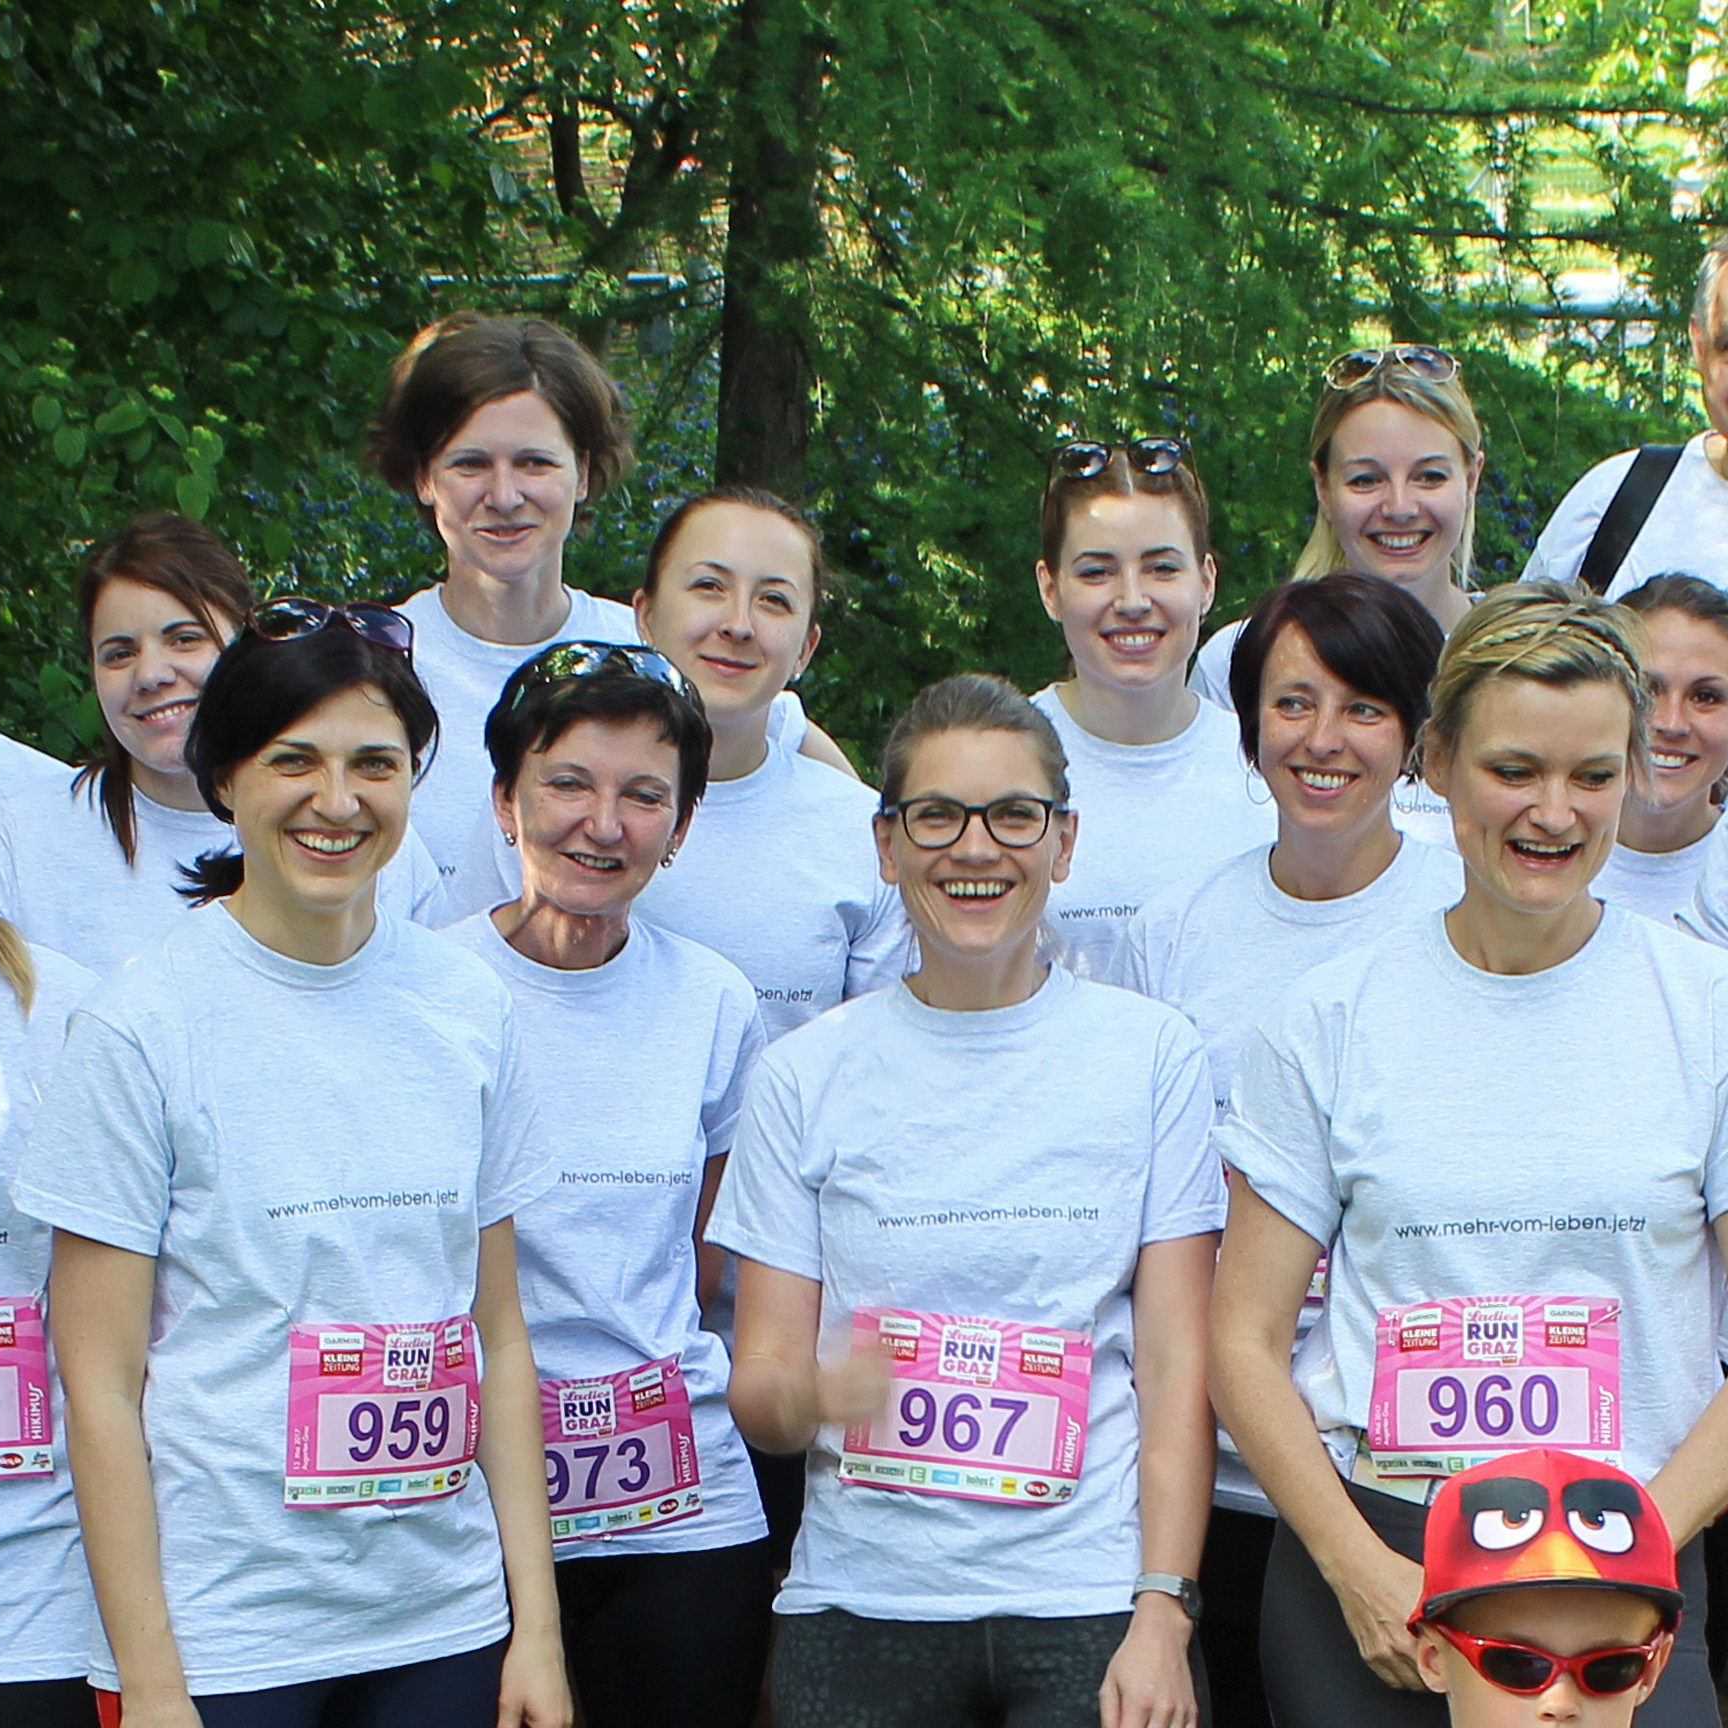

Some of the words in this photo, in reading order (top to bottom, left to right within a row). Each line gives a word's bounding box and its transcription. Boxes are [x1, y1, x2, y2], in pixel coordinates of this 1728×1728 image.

[1059, 904, 1138, 920] www.mehr
[876, 1205, 1099, 1228] www.mehr-vom-leben.jetzt
[1394, 1215, 1646, 1239] www.mehr-vom-leben.jetzt
[1406, 1313, 1438, 1323] GARMIN
[1468, 1311, 1519, 1323] Ladies
[1549, 1310, 1585, 1318] GARMIN
[947, 1329, 998, 1344] Ladies
[1402, 1327, 1438, 1339] KLEINE
[1467, 1323, 1518, 1340] RUN
[1548, 1325, 1585, 1336] KLEINE
[325, 1337, 361, 1345] GARMIN
[389, 1336, 432, 1348] Ladies
[1026, 1338, 1061, 1349] GARMIN
[1402, 1337, 1438, 1348] ZEITUNG
[1548, 1335, 1586, 1345] ZEITUNG
[945, 1341, 995, 1362] RUN
[1467, 1342, 1517, 1355] GRAZ
[323, 1354, 360, 1363] KLEINE
[387, 1348, 430, 1366] RUN
[1024, 1353, 1061, 1367] KLEINE
[323, 1362, 360, 1372] ZEITUNG
[387, 1367, 428, 1382] GRAZ
[943, 1359, 993, 1377] GRAZ
[1023, 1363, 1060, 1376] ZEITUNG
[563, 1390, 610, 1401] Ladies
[634, 1386, 663, 1401] KLEINE
[28, 1382, 45, 1440] HIKIMUS
[564, 1398, 611, 1418] RUN
[1428, 1374, 1559, 1438] 960
[565, 1415, 612, 1431] GRAZ
[898, 1387, 1029, 1457] 967
[1599, 1386, 1615, 1445] HIKIMUS
[348, 1396, 450, 1462] 959
[1063, 1416, 1081, 1474] HIKIMUS
[678, 1433, 692, 1483] HIKIMUS
[545, 1437, 650, 1504] 973
